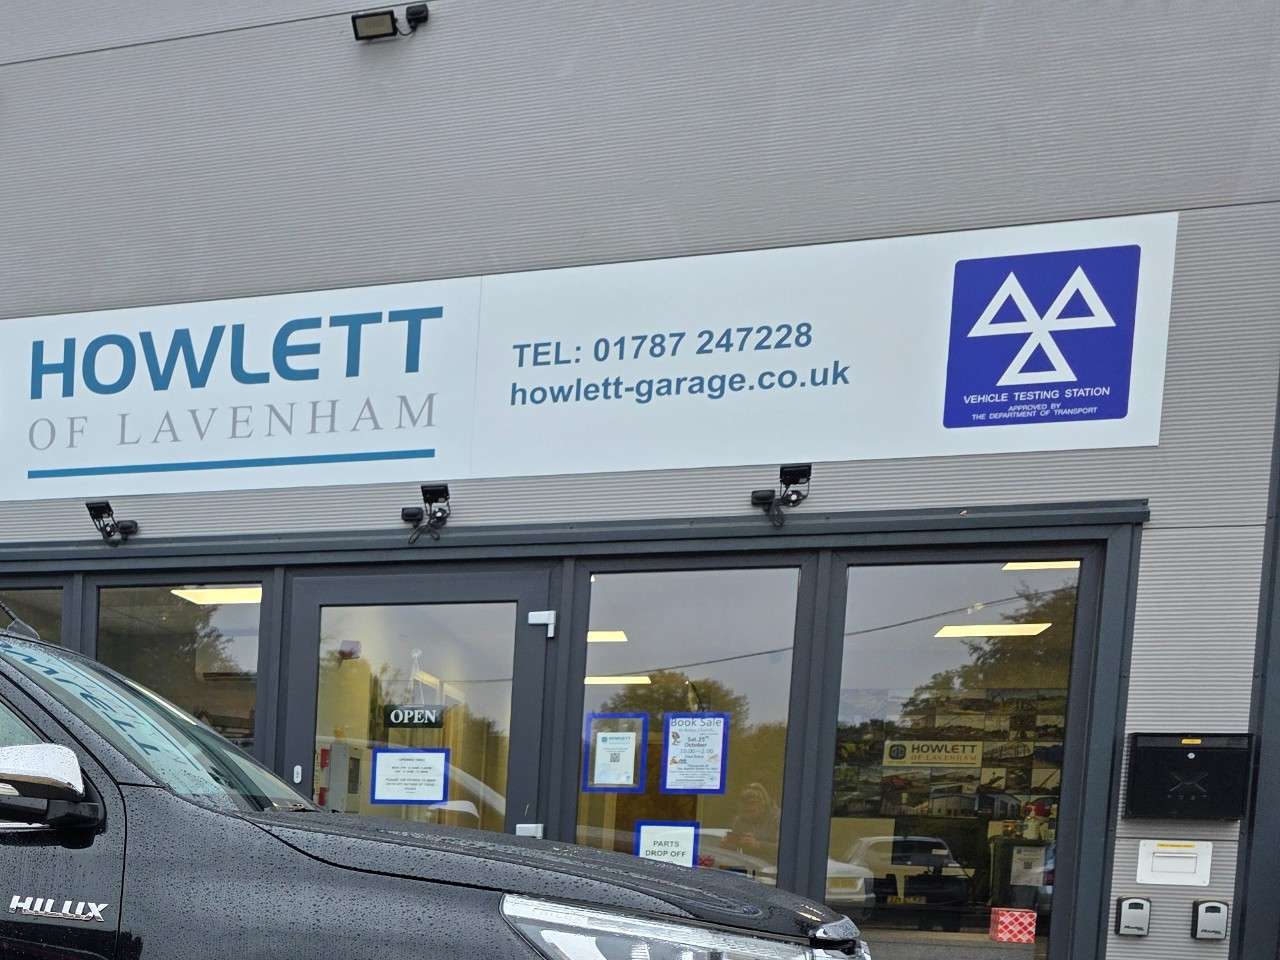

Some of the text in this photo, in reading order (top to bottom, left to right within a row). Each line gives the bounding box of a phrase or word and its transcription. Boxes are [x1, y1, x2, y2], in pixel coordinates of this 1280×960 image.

[512, 322, 813, 367] TEL: 01787 247228
[30, 306, 443, 400] HOWLETT
[510, 360, 850, 406] howlett-garage.co.uk
[963, 386, 1111, 404] VEHICLE TESTING STATION
[971, 406, 1098, 421] THE DEPARTMENT OF TRANSPORT
[1008, 402, 1062, 412] APPROVED BY
[28, 392, 439, 451] OF LAVENHAM
[390, 708, 437, 724] OPEN
[670, 718, 722, 727] Book Sale
[911, 743, 978, 754] HOWLETT
[653, 840, 680, 848] PARTS
[645, 849, 687, 858] DROP OFF
[9, 895, 109, 922] HILUX
